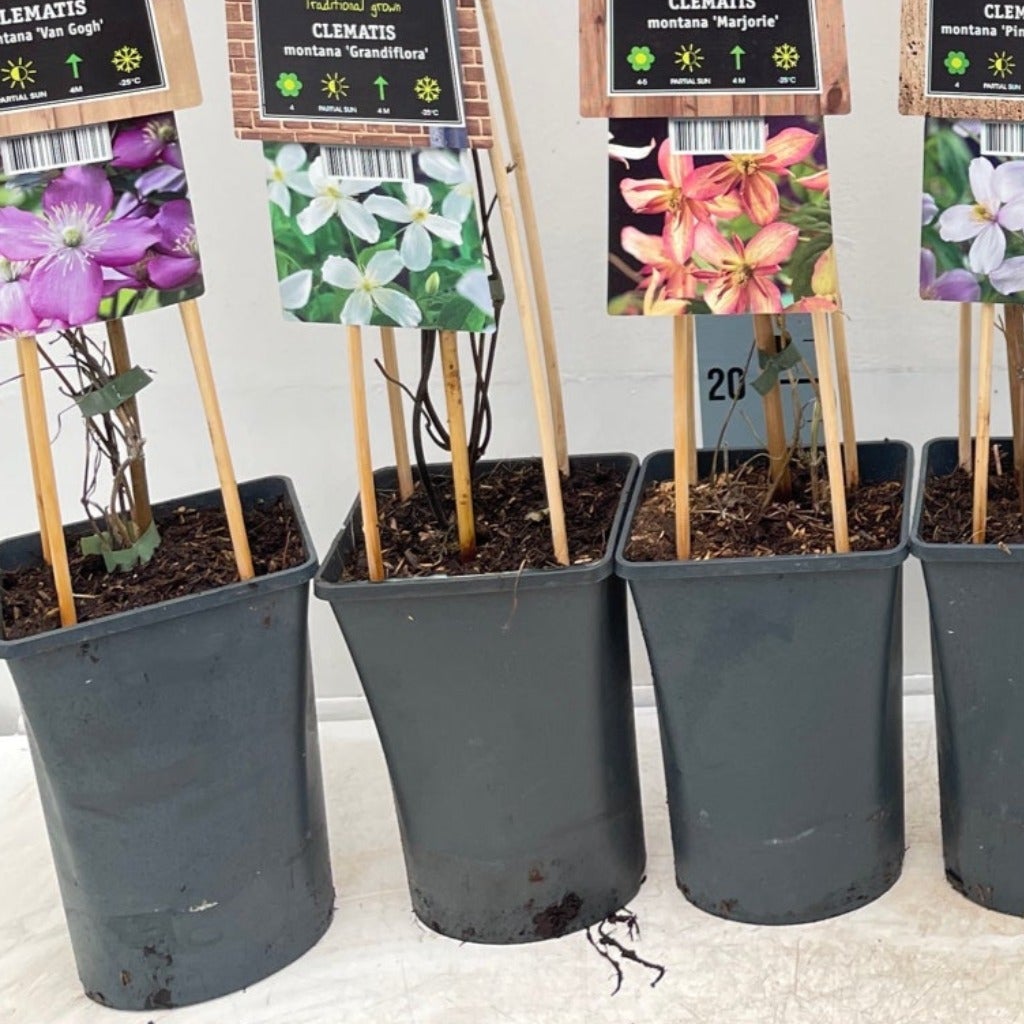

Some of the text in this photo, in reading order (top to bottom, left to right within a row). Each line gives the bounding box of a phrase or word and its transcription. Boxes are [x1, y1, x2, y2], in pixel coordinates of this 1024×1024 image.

[371, 3, 401, 17] grown
[37, 26, 64, 41] 'Van
[68, 18, 104, 36] Gogh'
[647, 14, 779, 31] montana 'Marjorie'
[312, 23, 396, 41] CLEMATIS
[941, 25, 997, 37] montana
[284, 45, 428, 60] montana 'Grandiflora'
[697, 77, 711, 85] SUN
[30, 91, 48, 99] SUN
[707, 367, 746, 401] 20
